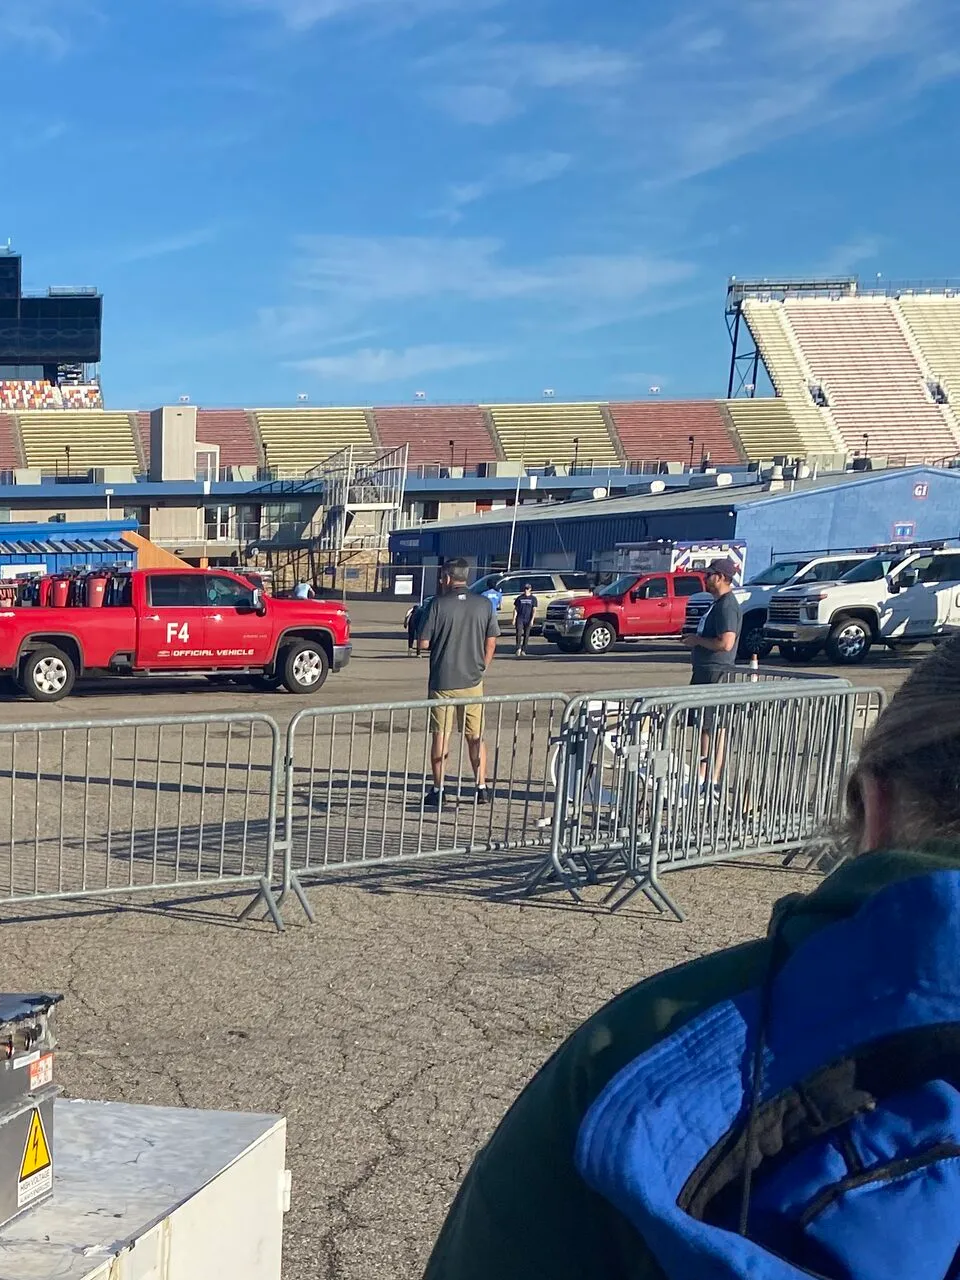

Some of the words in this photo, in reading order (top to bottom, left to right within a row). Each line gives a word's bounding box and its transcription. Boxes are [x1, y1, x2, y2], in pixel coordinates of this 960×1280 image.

[166, 622, 189, 643] F4
[173, 649, 214, 657] OFFICIAL
[31, 1169, 50, 1186] VOLTAGE
